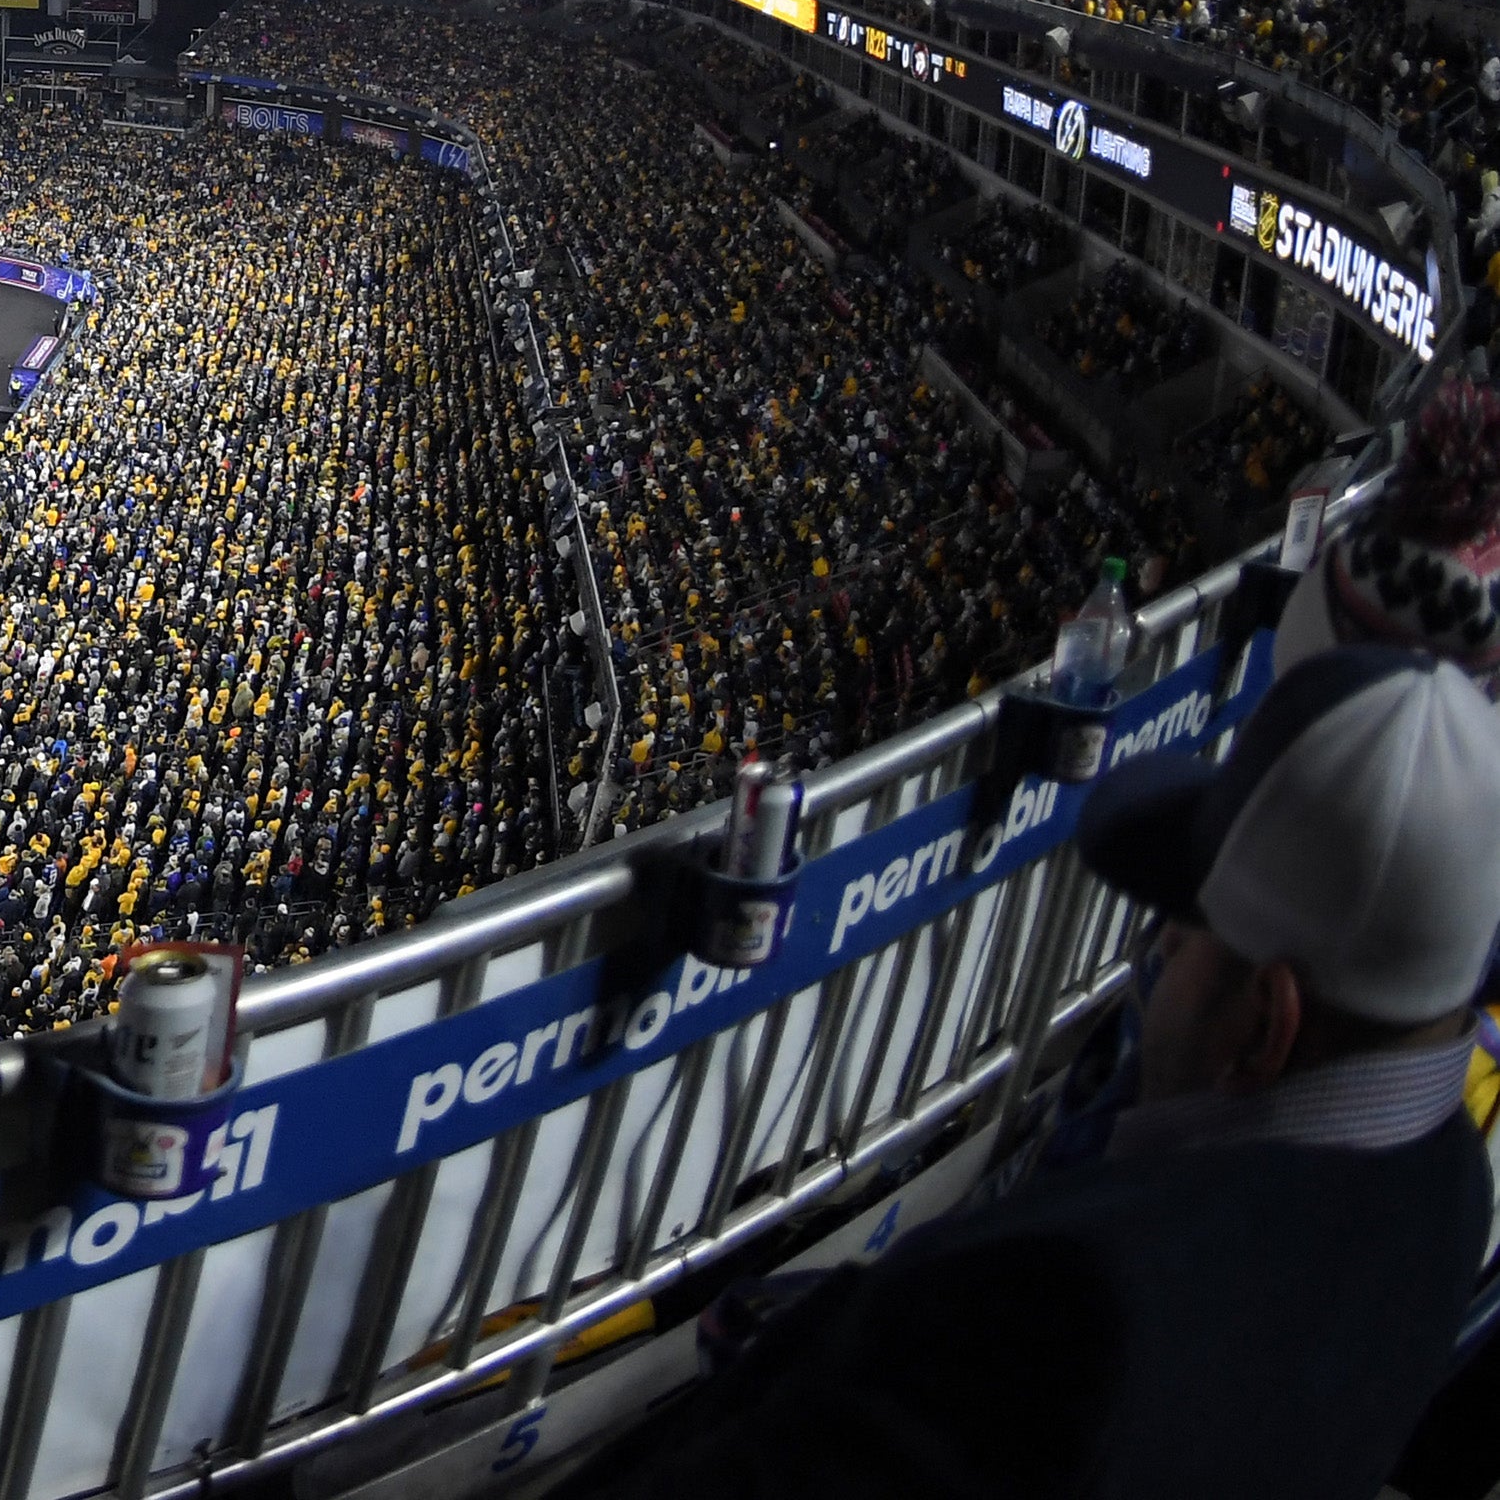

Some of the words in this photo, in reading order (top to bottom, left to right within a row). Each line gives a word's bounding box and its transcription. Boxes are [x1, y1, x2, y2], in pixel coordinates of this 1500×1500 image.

[33, 29, 56, 48] JACK
[91, 13, 125, 23] TITAN
[865, 26, 887, 60] 18:23
[237, 105, 310, 133] BOLTS
[1003, 86, 1032, 122] TAMPA
[1033, 99, 1054, 130] BAY
[1090, 125, 1151, 178] LIGHTNING
[1276, 202, 1376, 311] STADIUM
[1371, 261, 1435, 362] SERIE
[397, 952, 752, 1153] permob
[491, 1405, 547, 1473] 5
